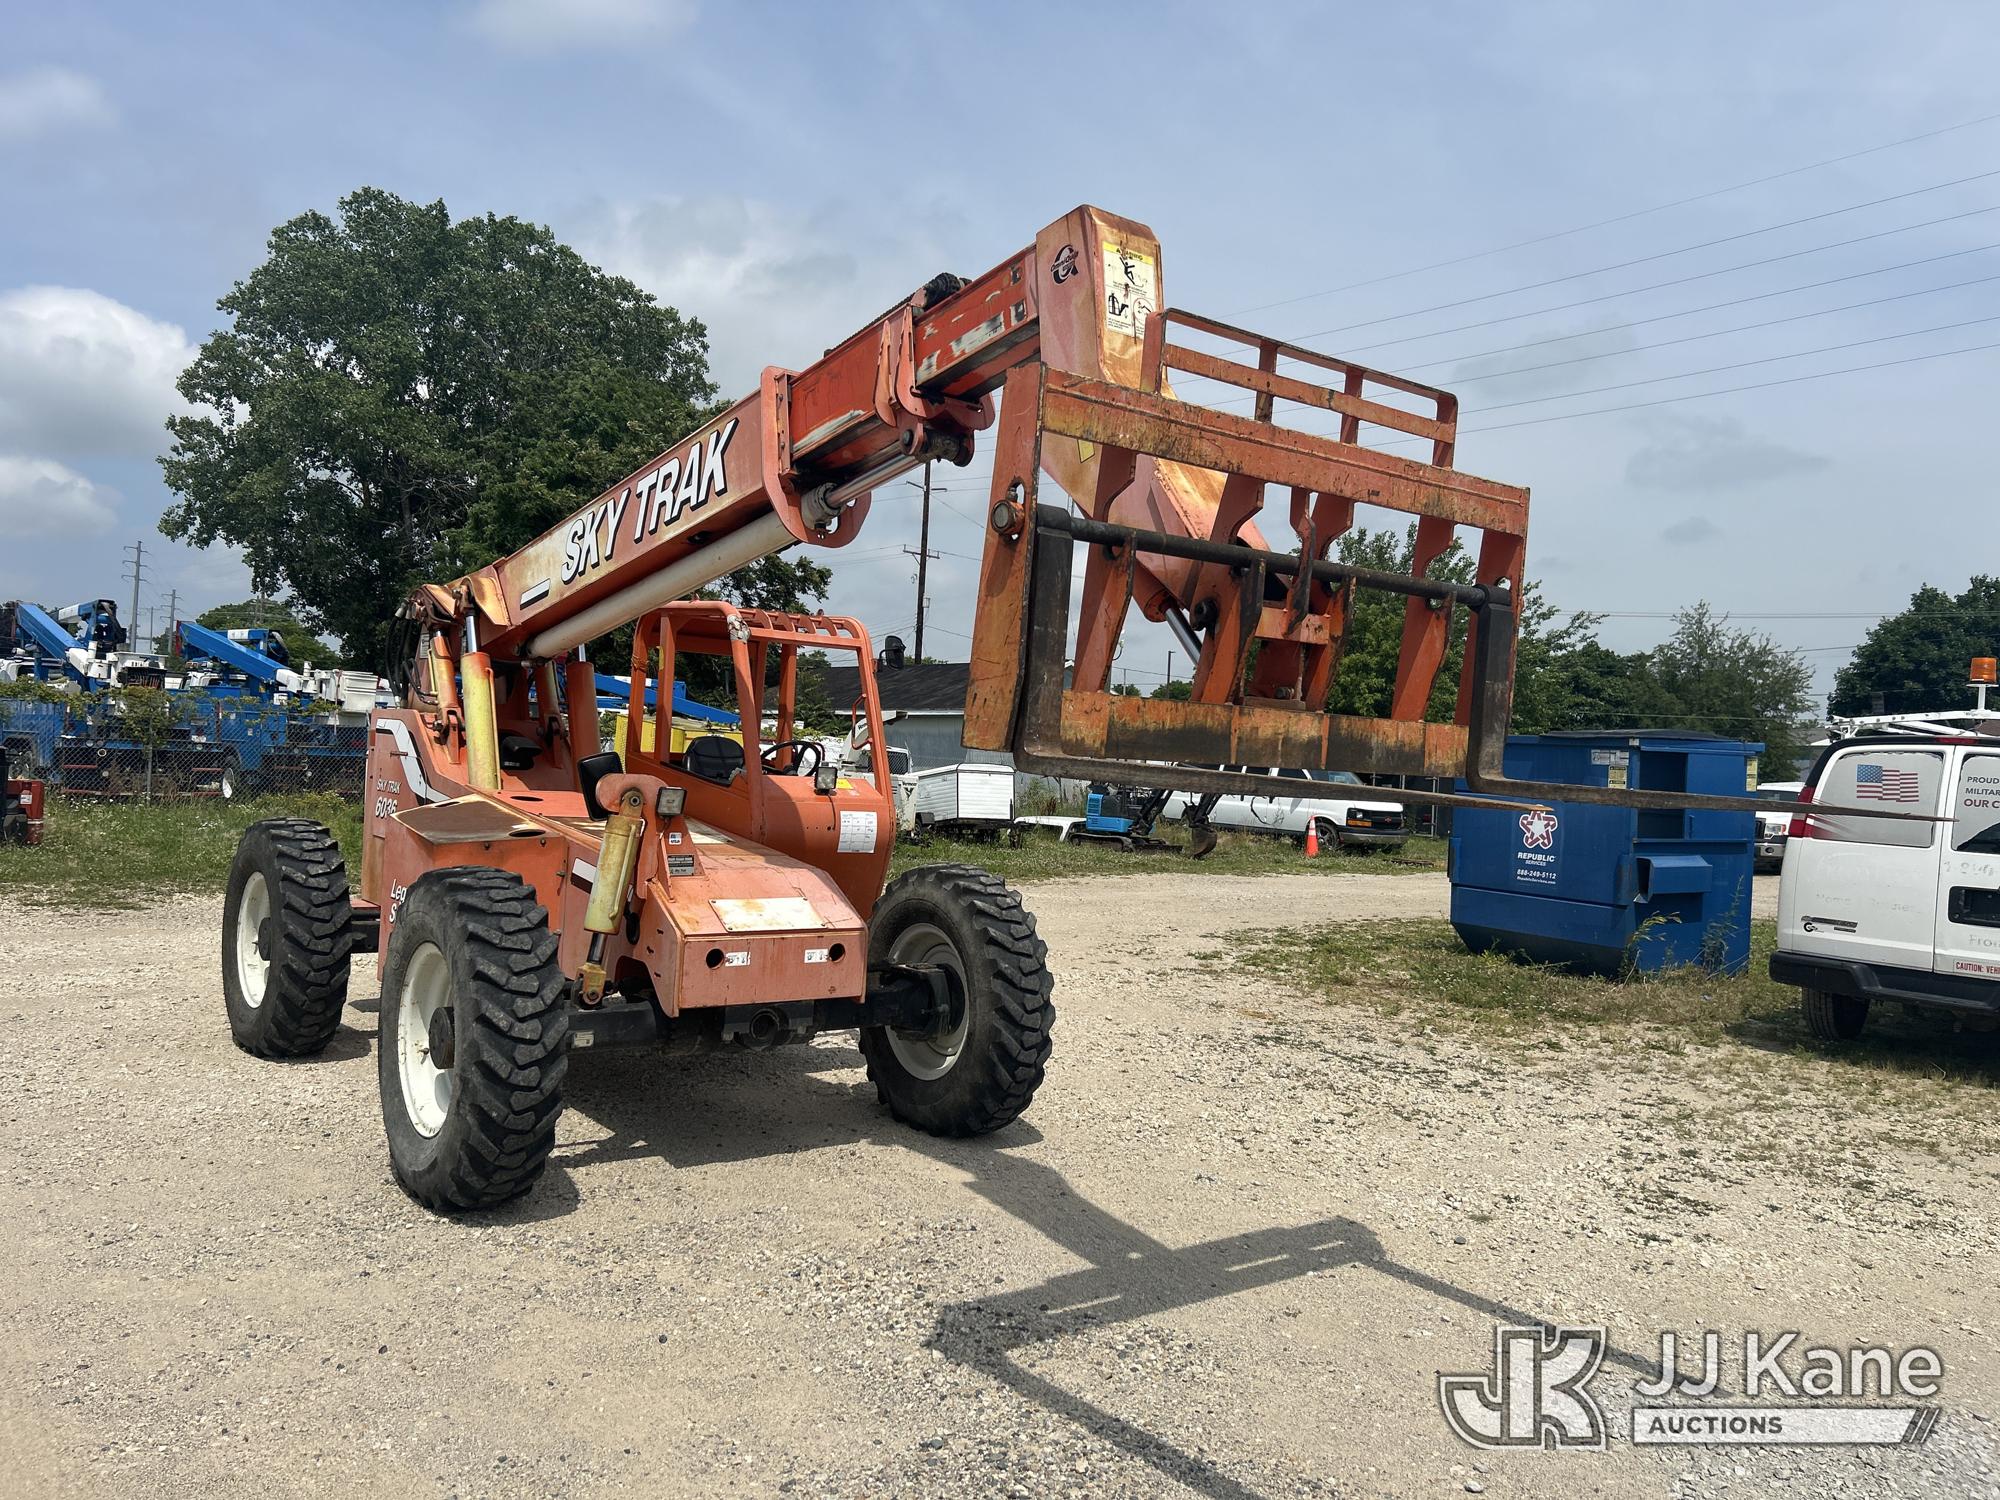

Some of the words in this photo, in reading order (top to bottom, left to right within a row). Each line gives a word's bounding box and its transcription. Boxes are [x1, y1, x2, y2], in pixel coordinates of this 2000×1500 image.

[560, 487, 631, 585] SKY
[634, 417, 739, 544] TRAK
[1967, 776, 2000, 785] PROUD
[375, 796, 398, 818] 6036
[1963, 798, 1990, 809] OUR
[1991, 800, 2000, 809] C
[1517, 851, 1555, 863] REPUBLIC
[1516, 868, 1557, 880] 888-249-5112
[390, 878, 408, 903] Leg
[1956, 961, 1984, 974] CAUTION:
